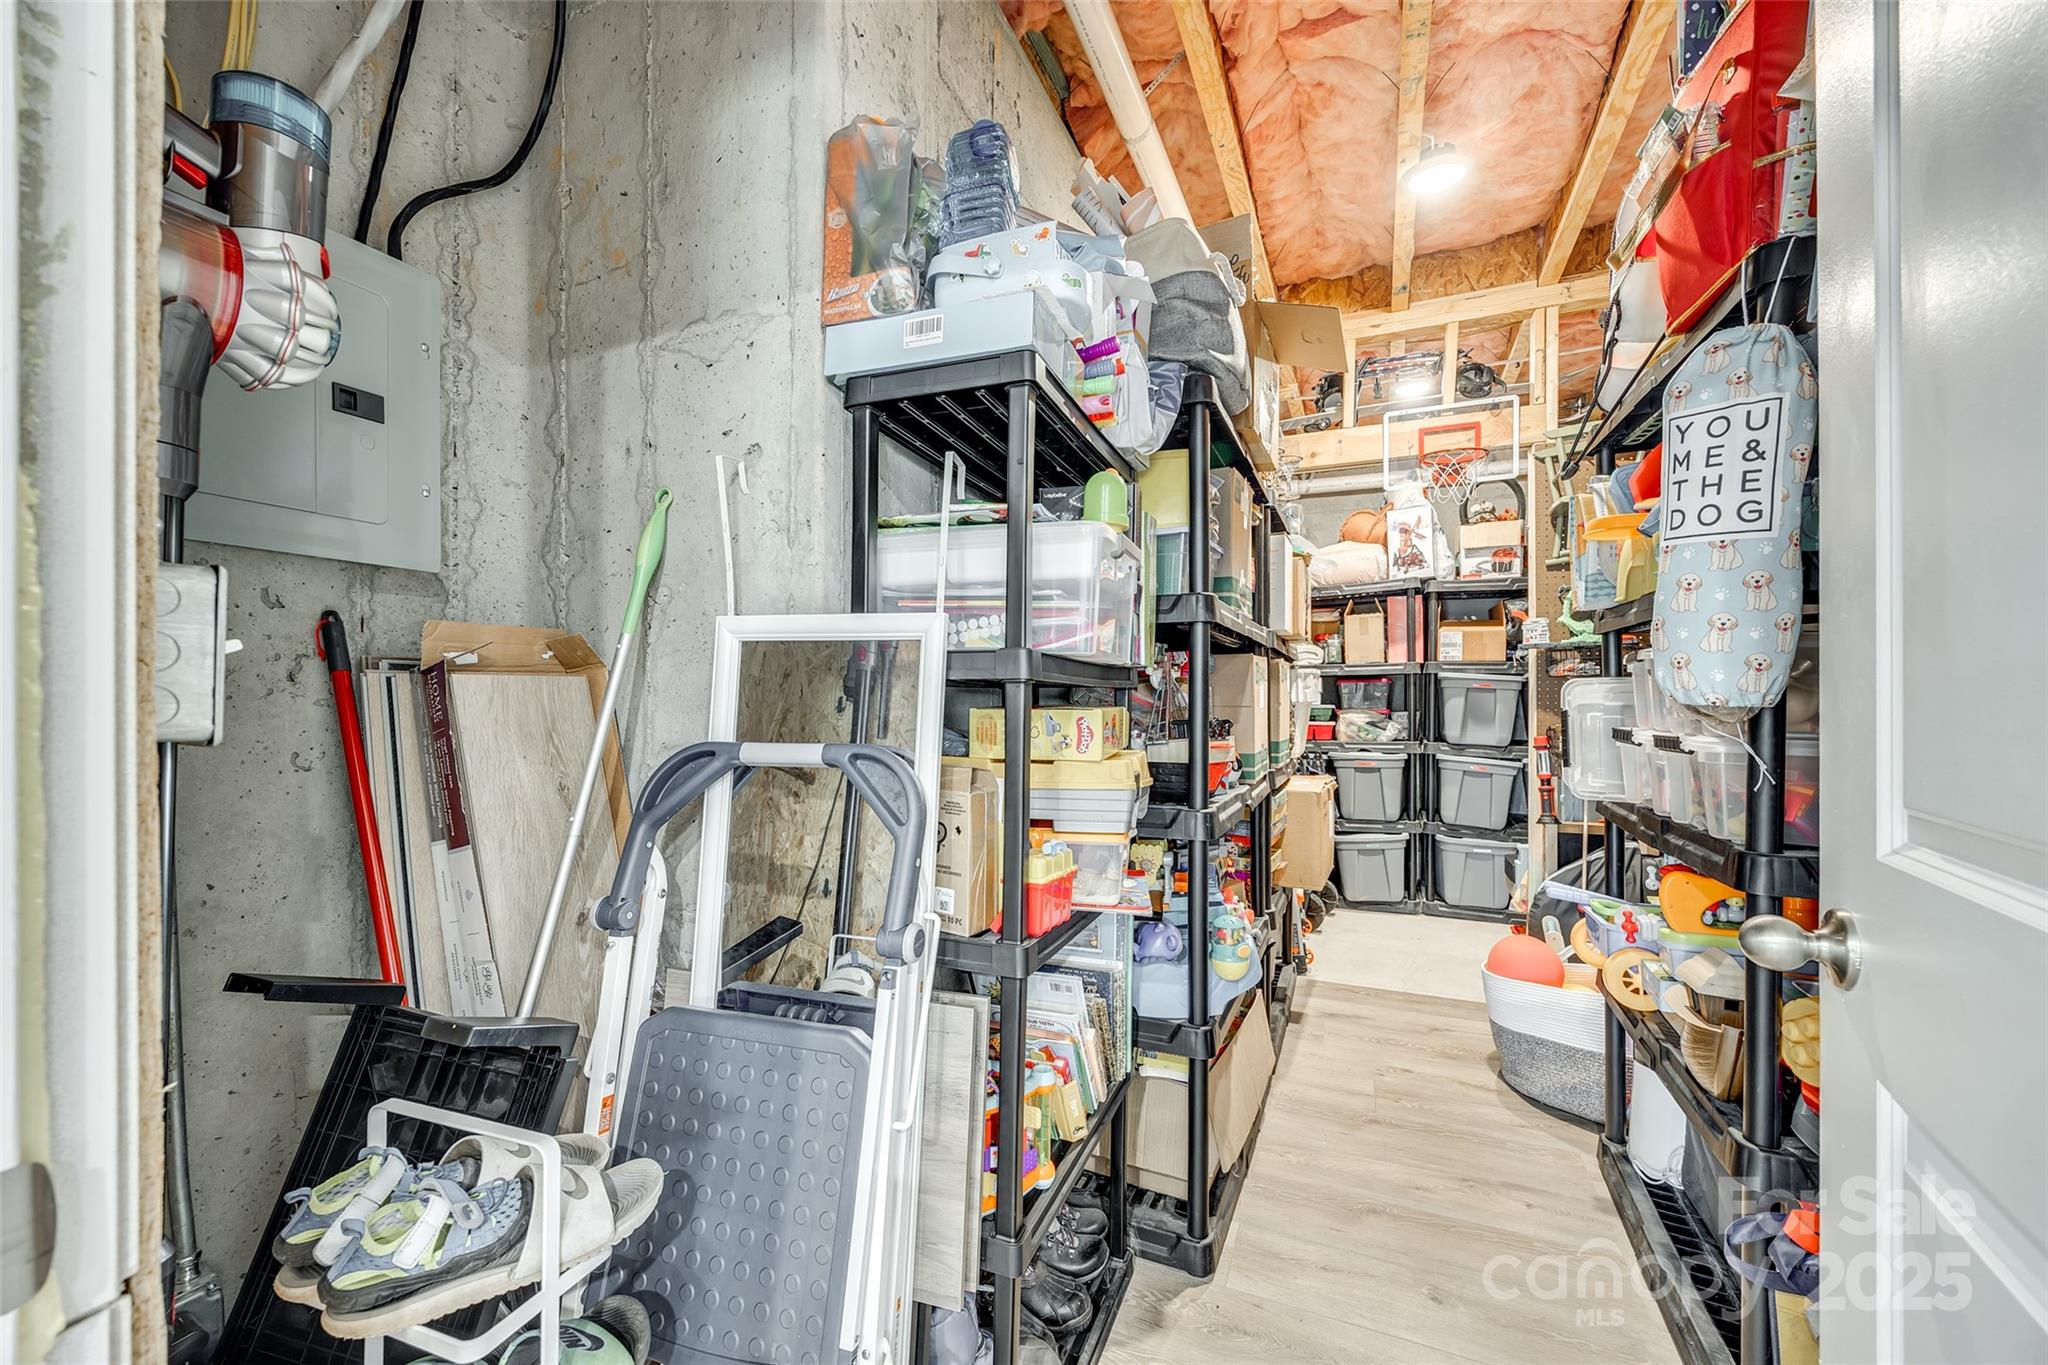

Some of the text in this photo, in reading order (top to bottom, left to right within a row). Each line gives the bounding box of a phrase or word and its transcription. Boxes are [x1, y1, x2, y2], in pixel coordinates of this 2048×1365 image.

[1675, 407, 1770, 444] YOU
[1672, 468, 1763, 502] THE
[1669, 499, 1763, 531] DOG
[429, 671, 443, 720] HOME
